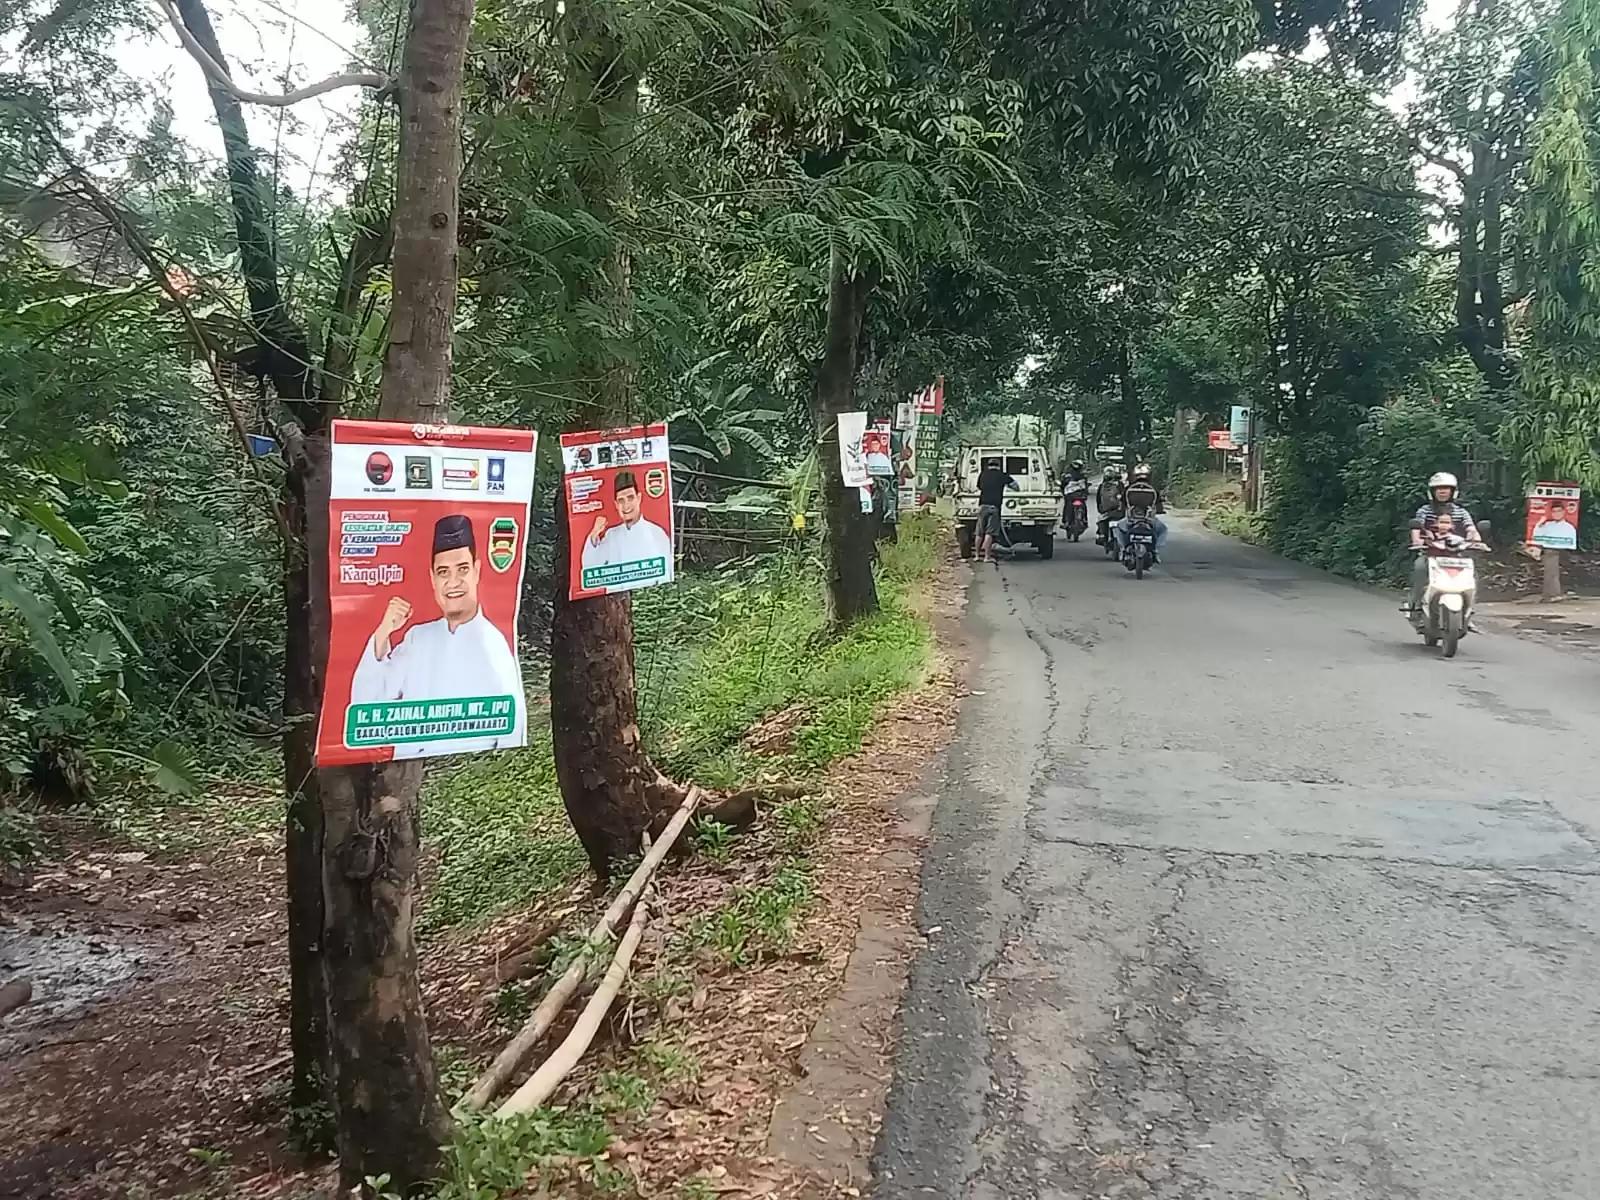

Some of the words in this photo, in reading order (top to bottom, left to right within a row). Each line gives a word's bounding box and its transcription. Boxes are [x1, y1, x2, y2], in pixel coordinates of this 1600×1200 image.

[487, 482, 505, 491] PAN
[343, 567, 377, 583] Kang
[357, 709, 370, 724] Ir.
[371, 708, 385, 723] H.
[386, 706, 426, 722] ZAINAL
[491, 700, 511, 715] IPU
[356, 728, 385, 740] BAKAL
[387, 725, 417, 737] CALON
[419, 722, 449, 735] BUPATI
[451, 718, 507, 732] PURWAKARTA
